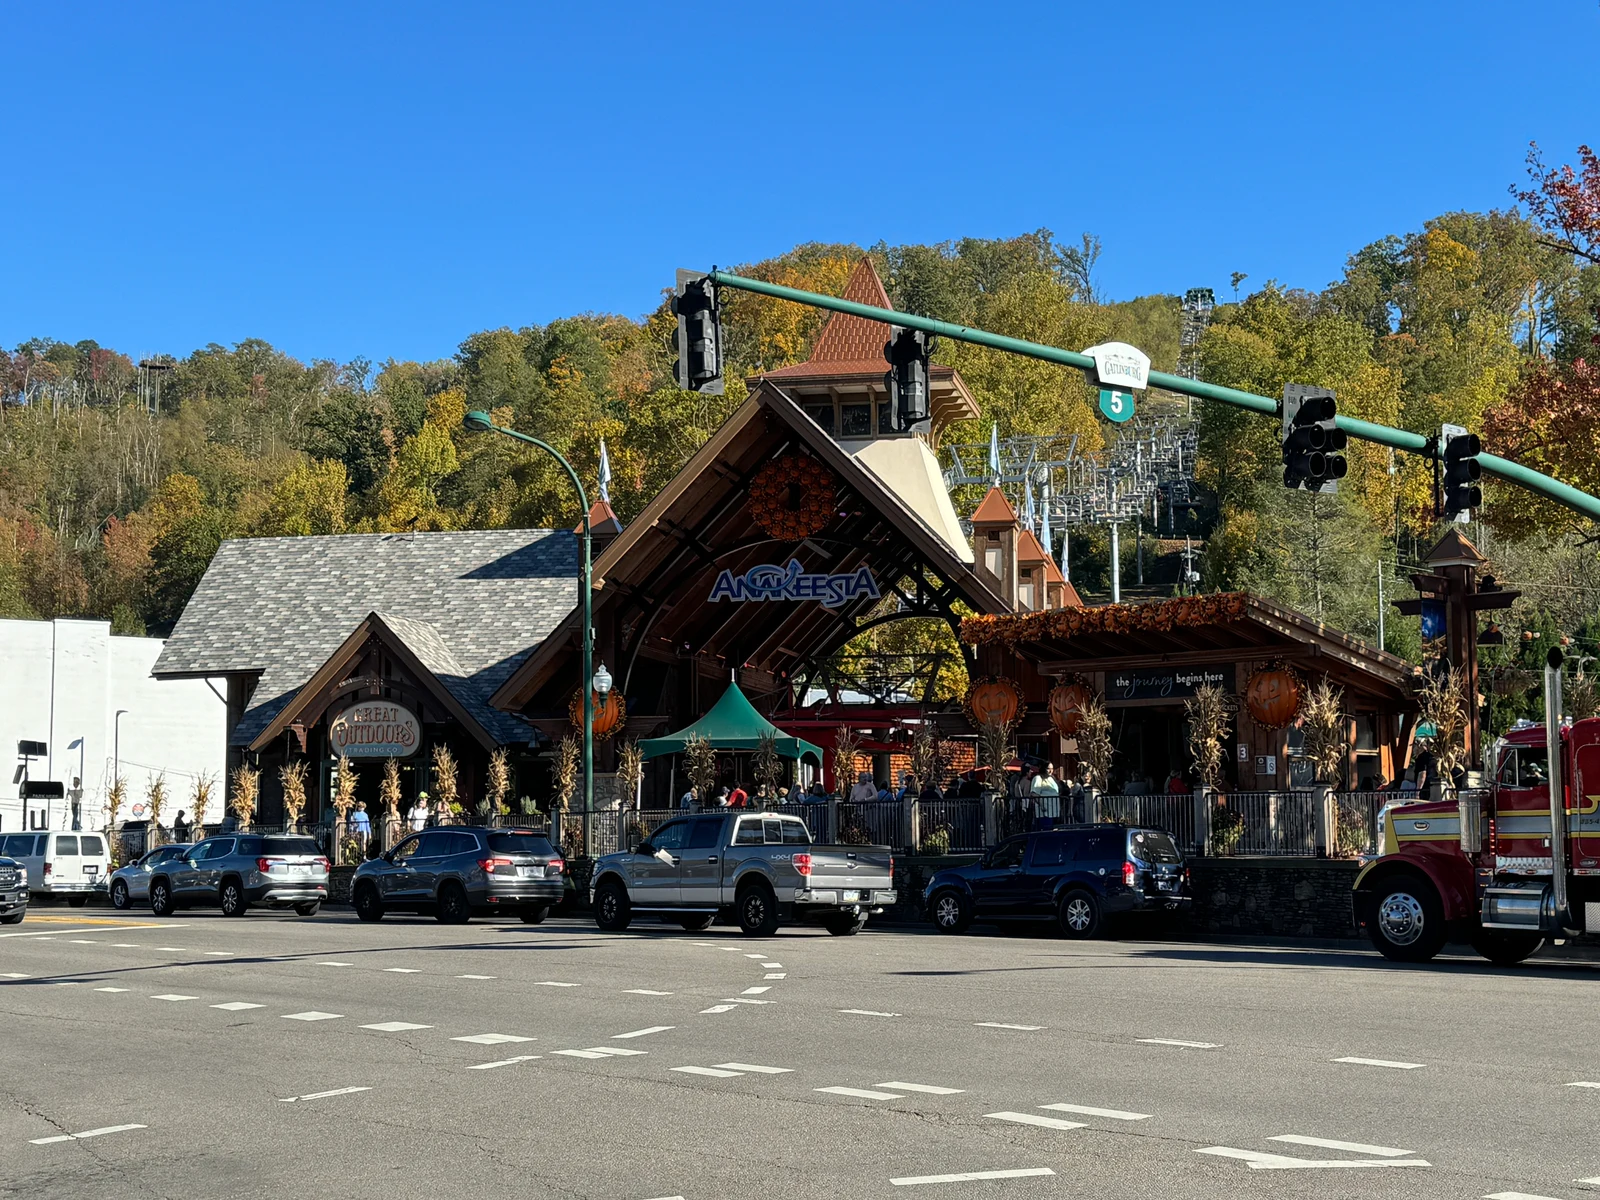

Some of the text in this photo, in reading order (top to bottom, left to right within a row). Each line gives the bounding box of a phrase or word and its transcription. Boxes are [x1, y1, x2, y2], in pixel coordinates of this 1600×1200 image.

[1111, 390, 1123, 414] 5
[708, 565, 881, 608] ANAKEESTA
[1116, 671, 1224, 698] the journey begins here
[353, 707, 399, 722] GREAT
[337, 720, 415, 747] OUTDOORS
[1240, 747, 1247, 759] 3
